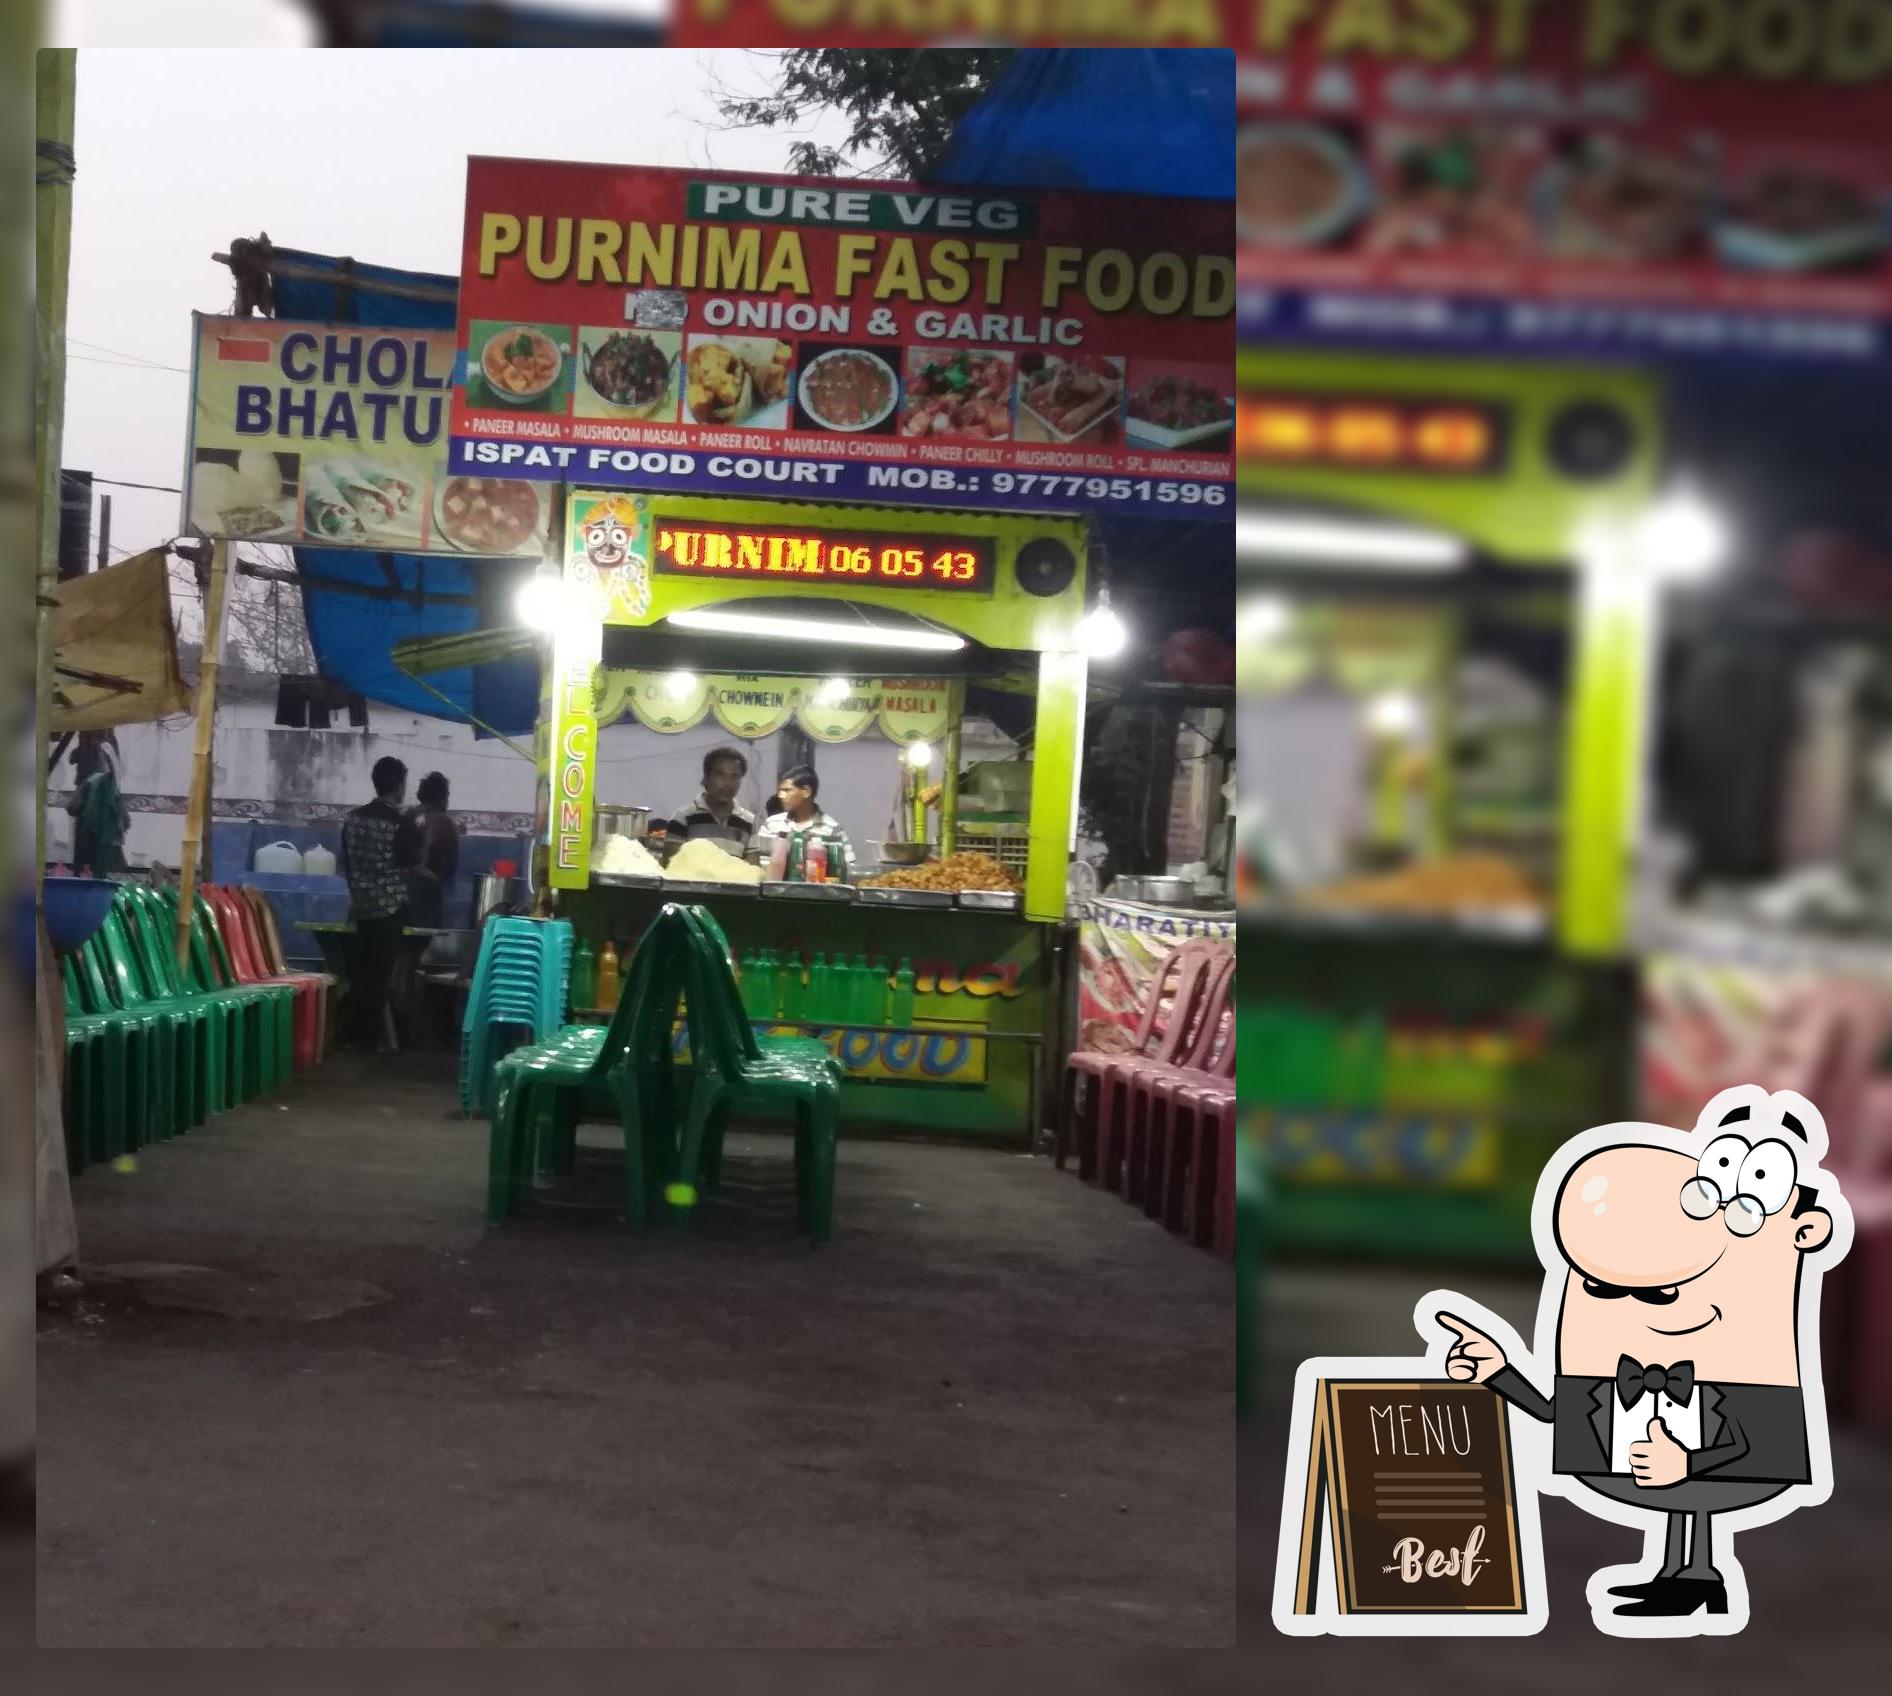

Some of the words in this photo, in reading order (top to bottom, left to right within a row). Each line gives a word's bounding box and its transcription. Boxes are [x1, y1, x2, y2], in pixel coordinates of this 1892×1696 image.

[704, 184, 870, 223] PURE
[894, 195, 1019, 230] VEG
[479, 212, 810, 294] PURNIMA
[835, 234, 1019, 305] FAST
[1041, 246, 1236, 318] FOOD
[704, 298, 849, 334] ONION
[867, 308, 898, 336] &
[915, 310, 1084, 346] GARLIC
[280, 332, 453, 389] CHOL
[463, 441, 577, 468] ISPAT
[588, 449, 696, 475] FOOD
[707, 456, 845, 484] COURT
[867, 465, 980, 491] MOB.:
[991, 472, 1227, 506] 9777951596
[473, 418, 515, 435] PANEER
[517, 421, 561, 438] MASALA
[573, 425, 641, 442] MUSHROOM
[643, 430, 688, 446] MASALA
[700, 432, 742, 449] PANEER
[742, 434, 772, 451] ROLL
[784, 438, 845, 455] NAVRATAN
[920, 445, 962, 461] PANEER
[965, 447, 1004, 463] CHILLY
[1015, 451, 1084, 468] MUSHROOM
[1086, 454, 1114, 469] ROLL
[1126, 456, 1149, 472] SPL.
[1151, 458, 1231, 476] MANCHURIAN
[829, 546, 872, 574] 06
[880, 548, 924, 577] 05
[930, 551, 977, 581] 43
[885, 695, 937, 714] MASALA
[558, 662, 590, 870] ELCOME
